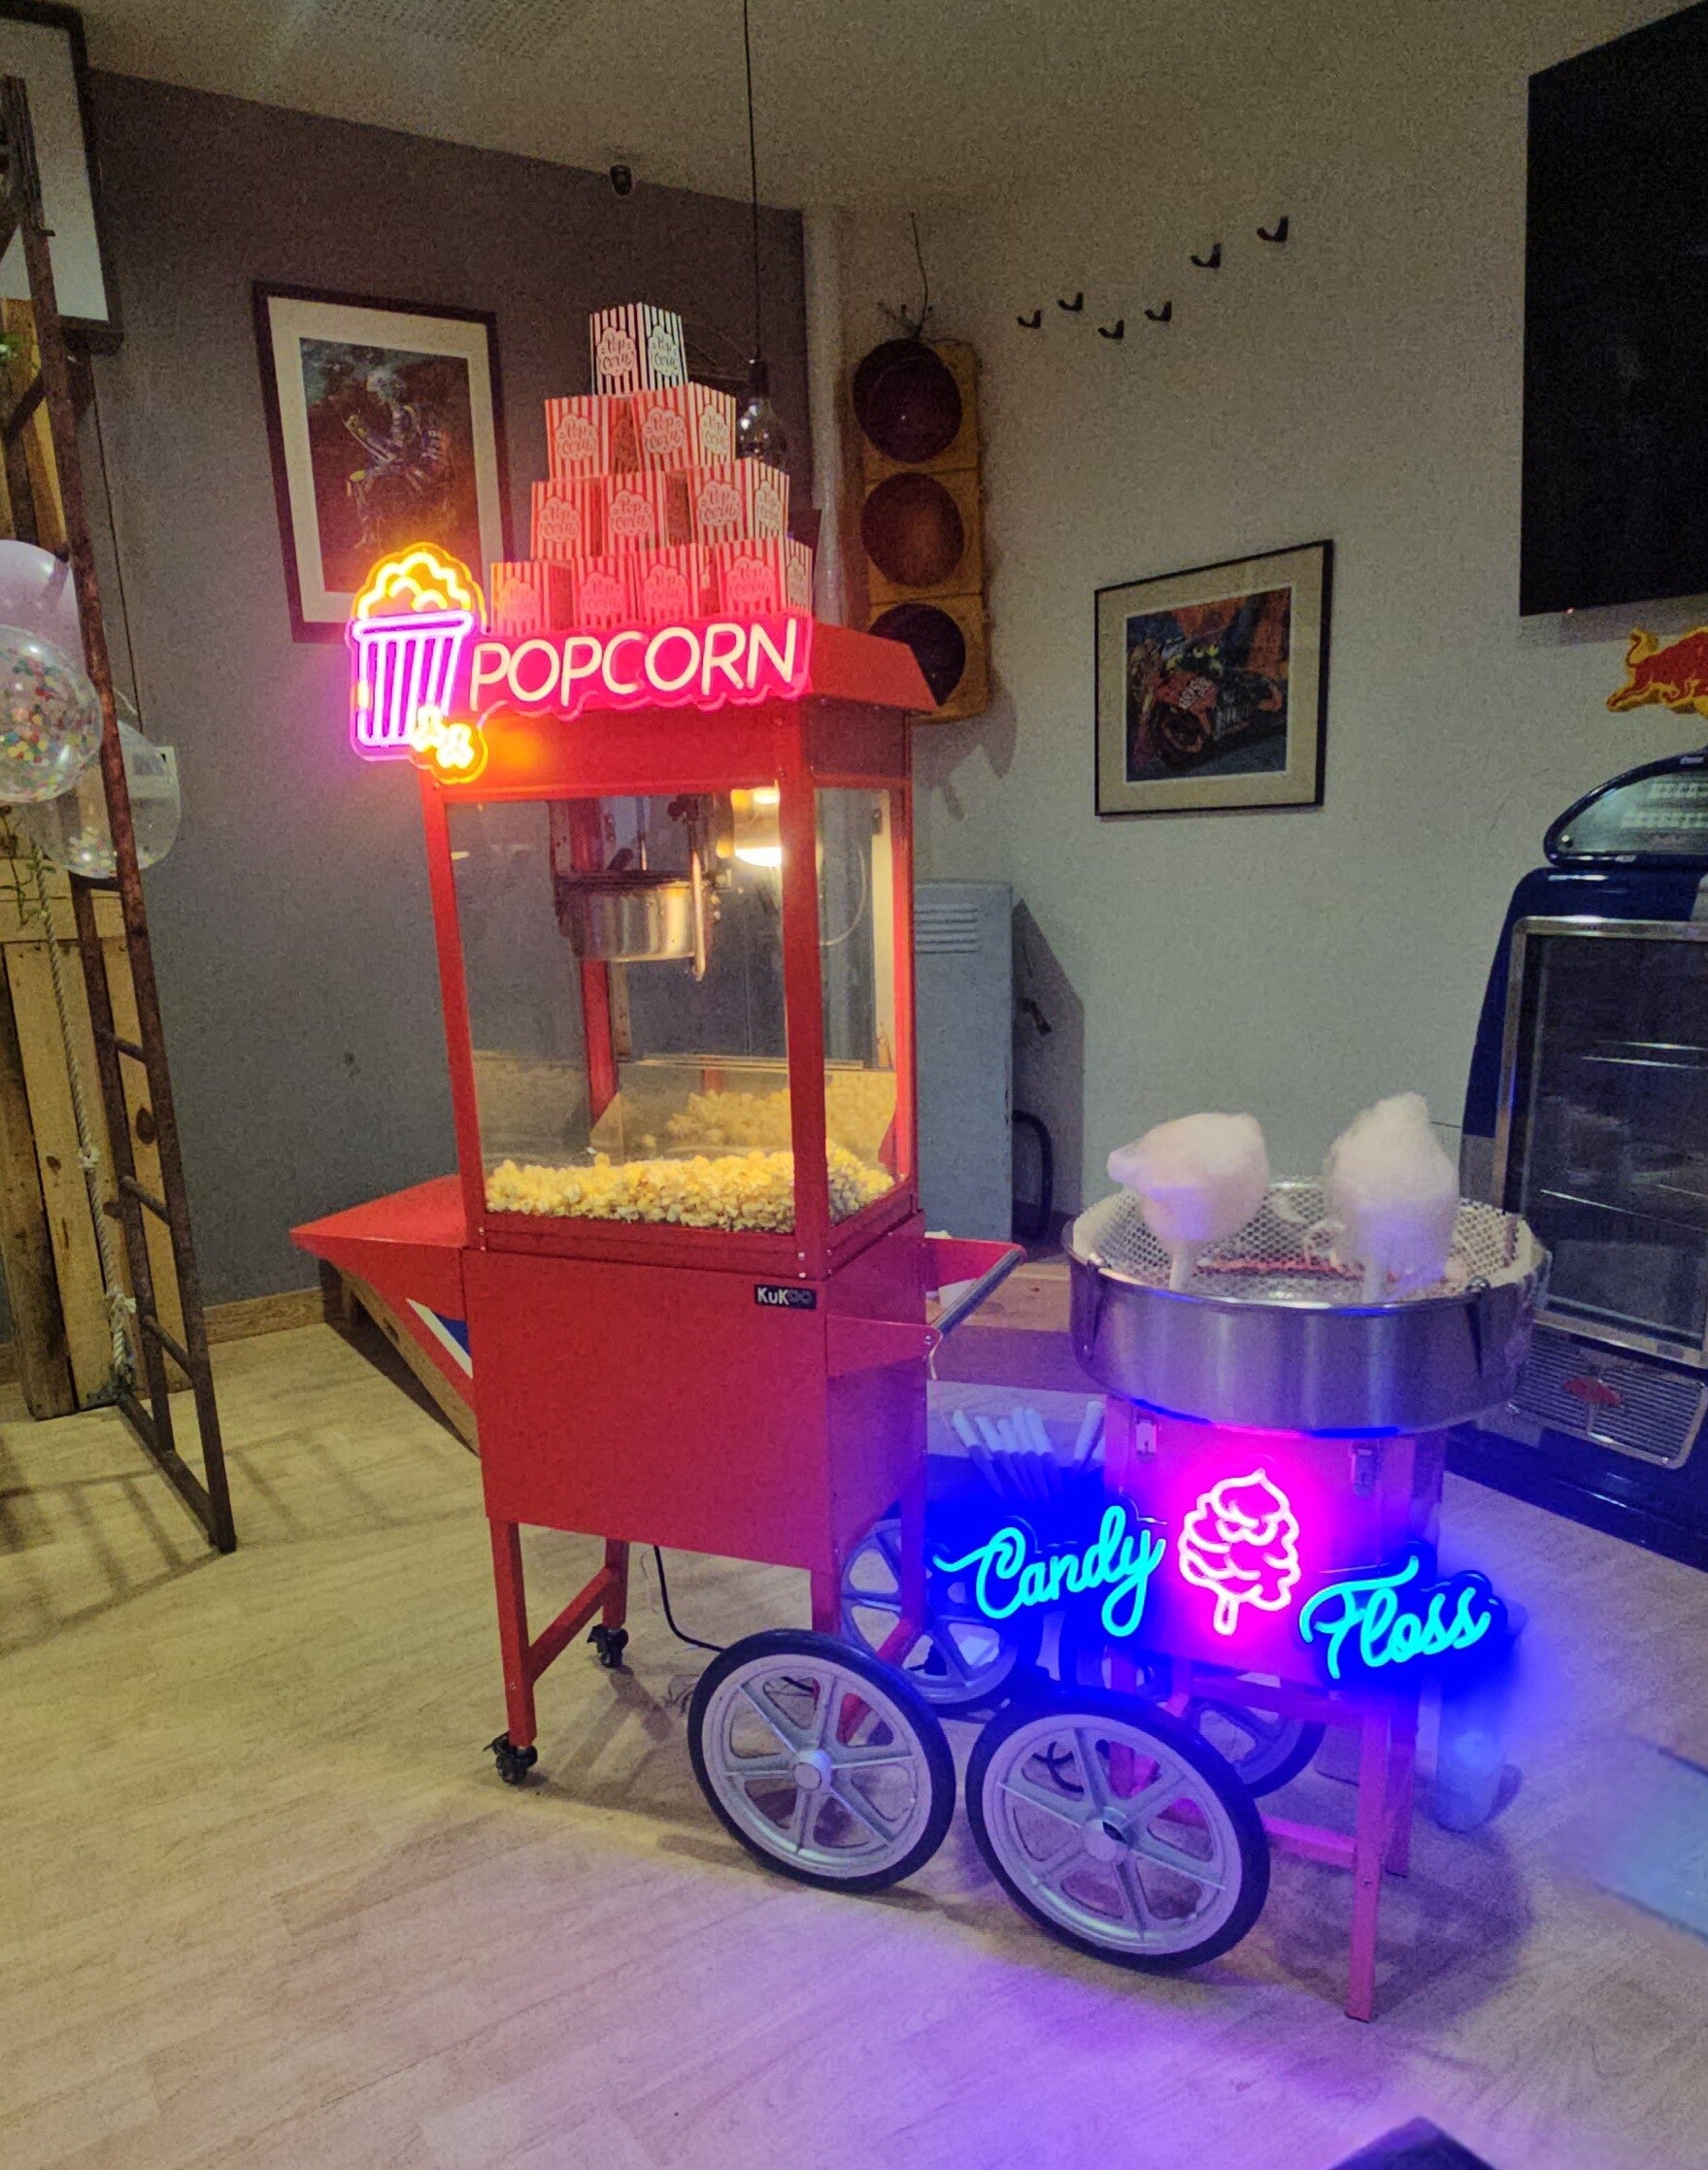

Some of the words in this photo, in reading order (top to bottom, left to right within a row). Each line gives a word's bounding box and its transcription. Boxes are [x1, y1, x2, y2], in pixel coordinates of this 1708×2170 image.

[470, 618, 796, 711] POPCORN
[933, 1506, 1166, 1637] Candy
[1300, 1555, 1491, 1678] Floss
